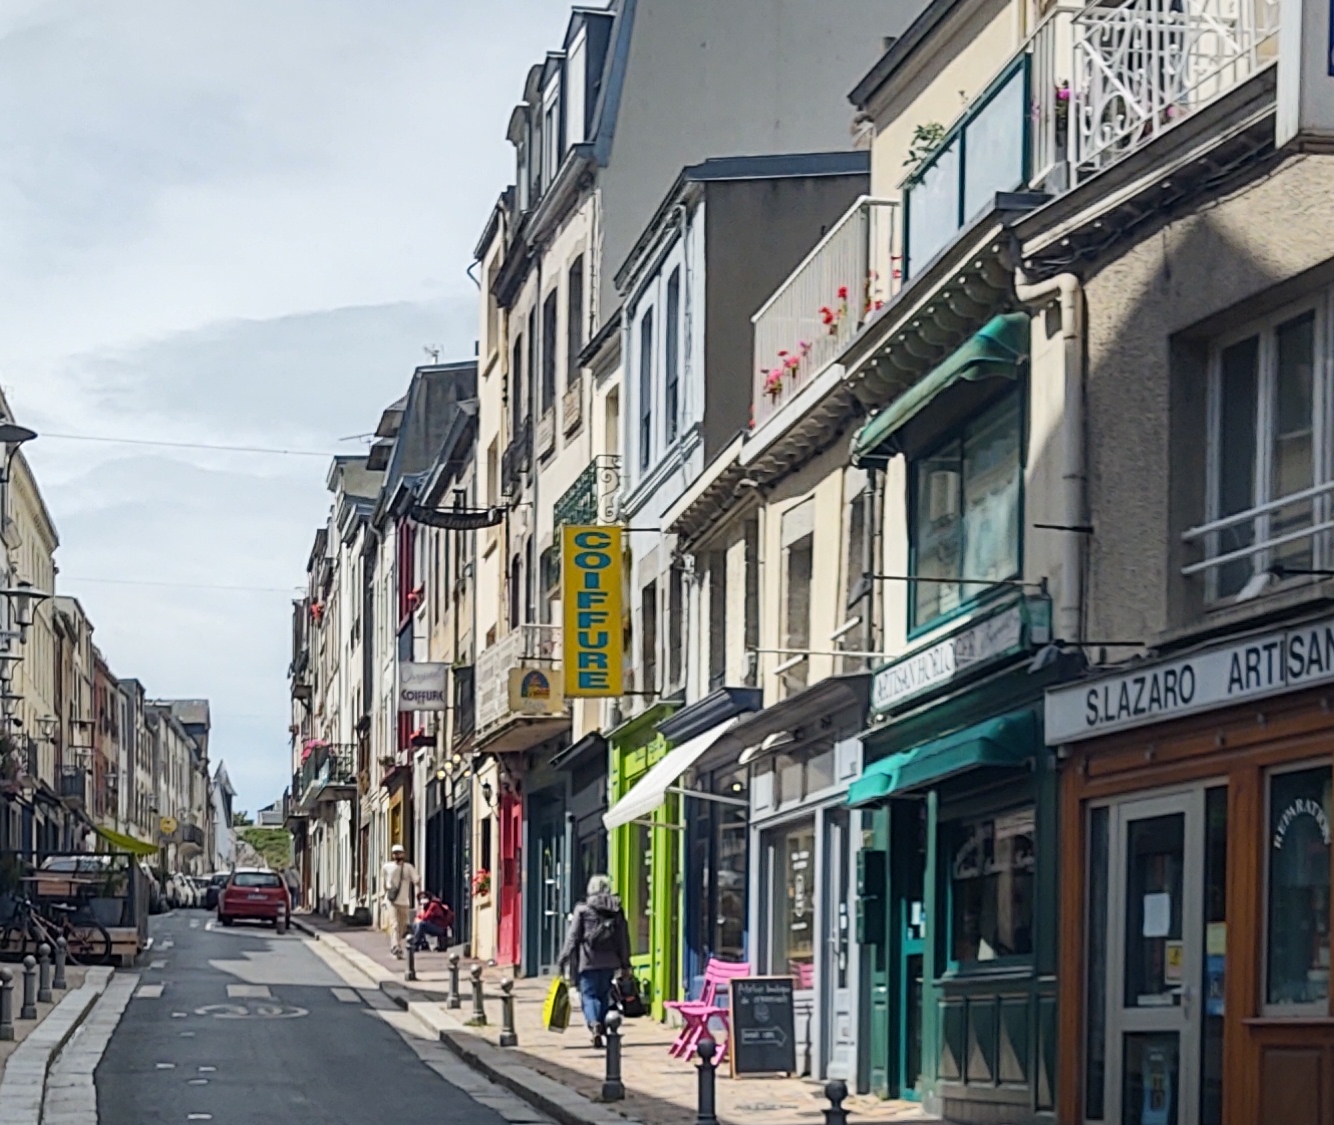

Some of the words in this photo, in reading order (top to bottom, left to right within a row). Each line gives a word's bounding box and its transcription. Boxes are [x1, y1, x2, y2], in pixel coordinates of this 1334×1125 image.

[574, 531, 612, 689] COIFFURE
[401, 689, 444, 705] COIFFURE
[1085, 664, 1195, 726] S.LAZARO
